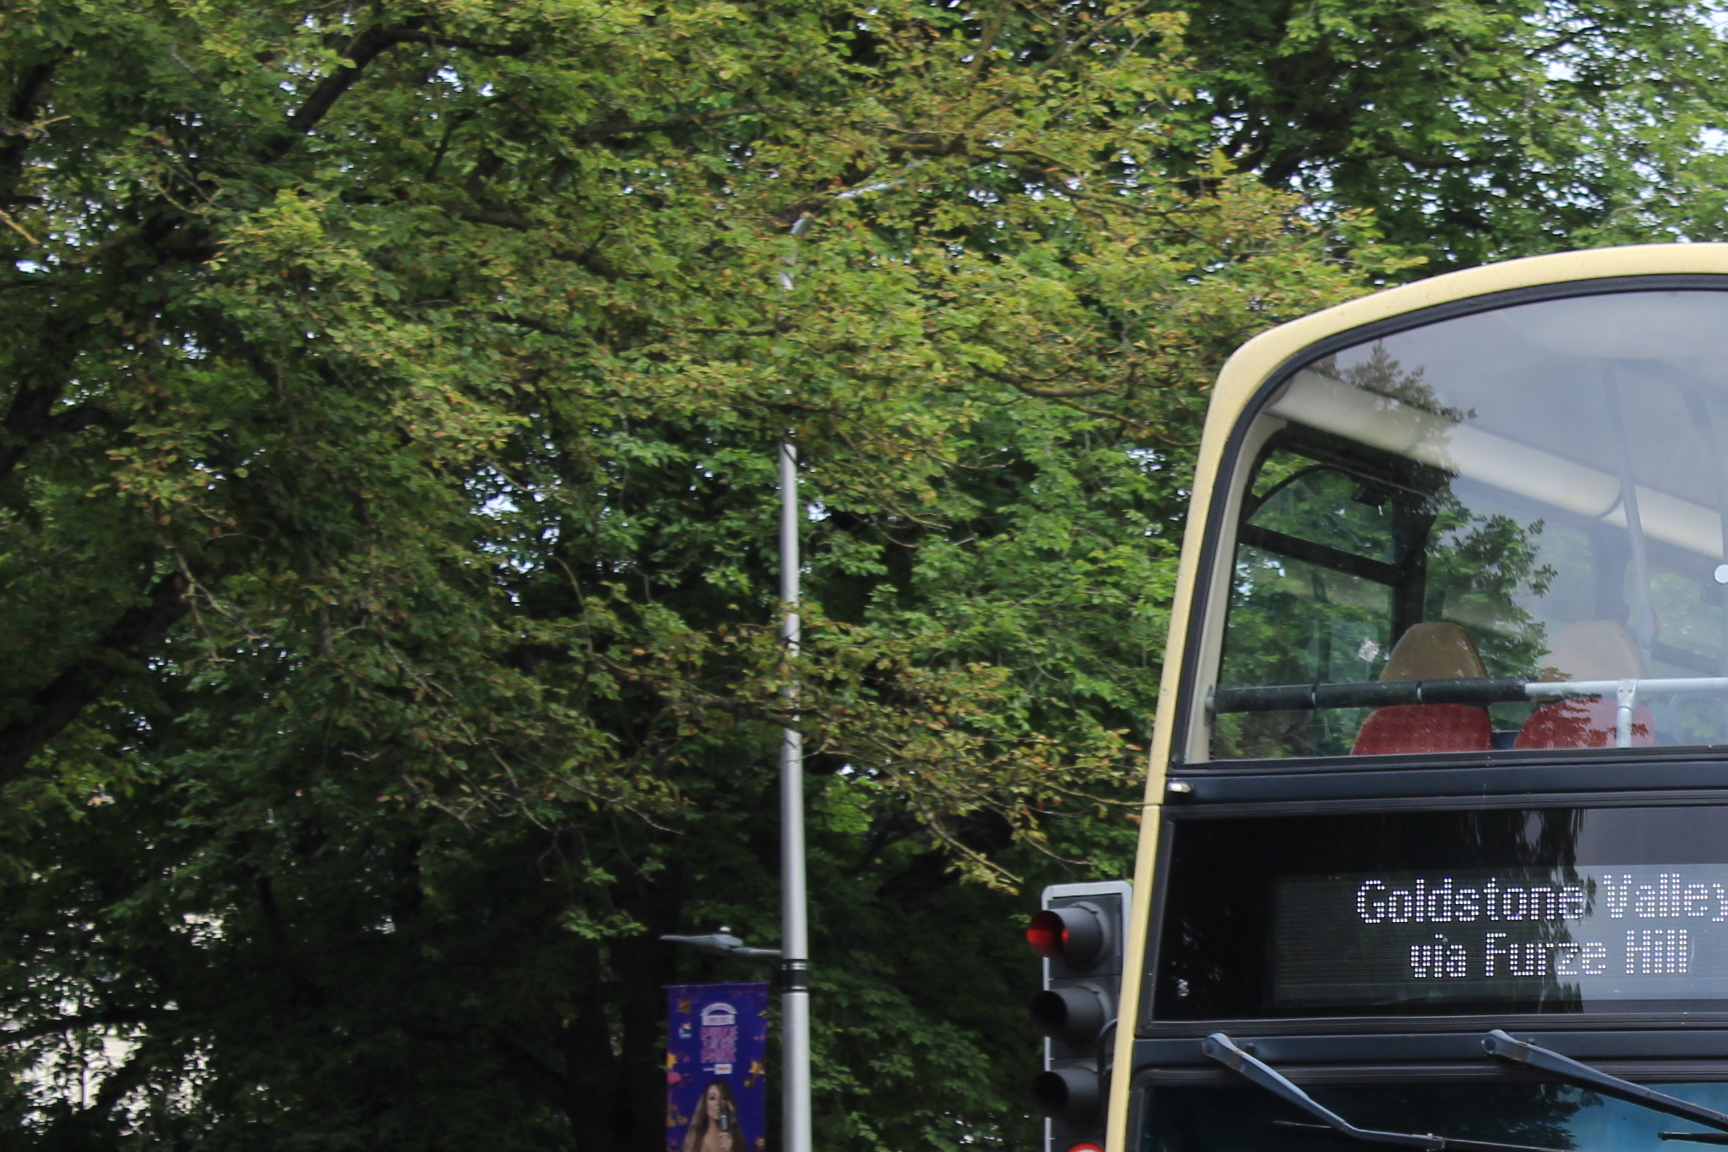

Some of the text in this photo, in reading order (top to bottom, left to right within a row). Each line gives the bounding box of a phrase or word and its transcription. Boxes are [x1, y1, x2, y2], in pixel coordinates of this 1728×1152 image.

[1355, 877, 1583, 923] Goldstone
[1409, 928, 1687, 978] via Furze Hill
